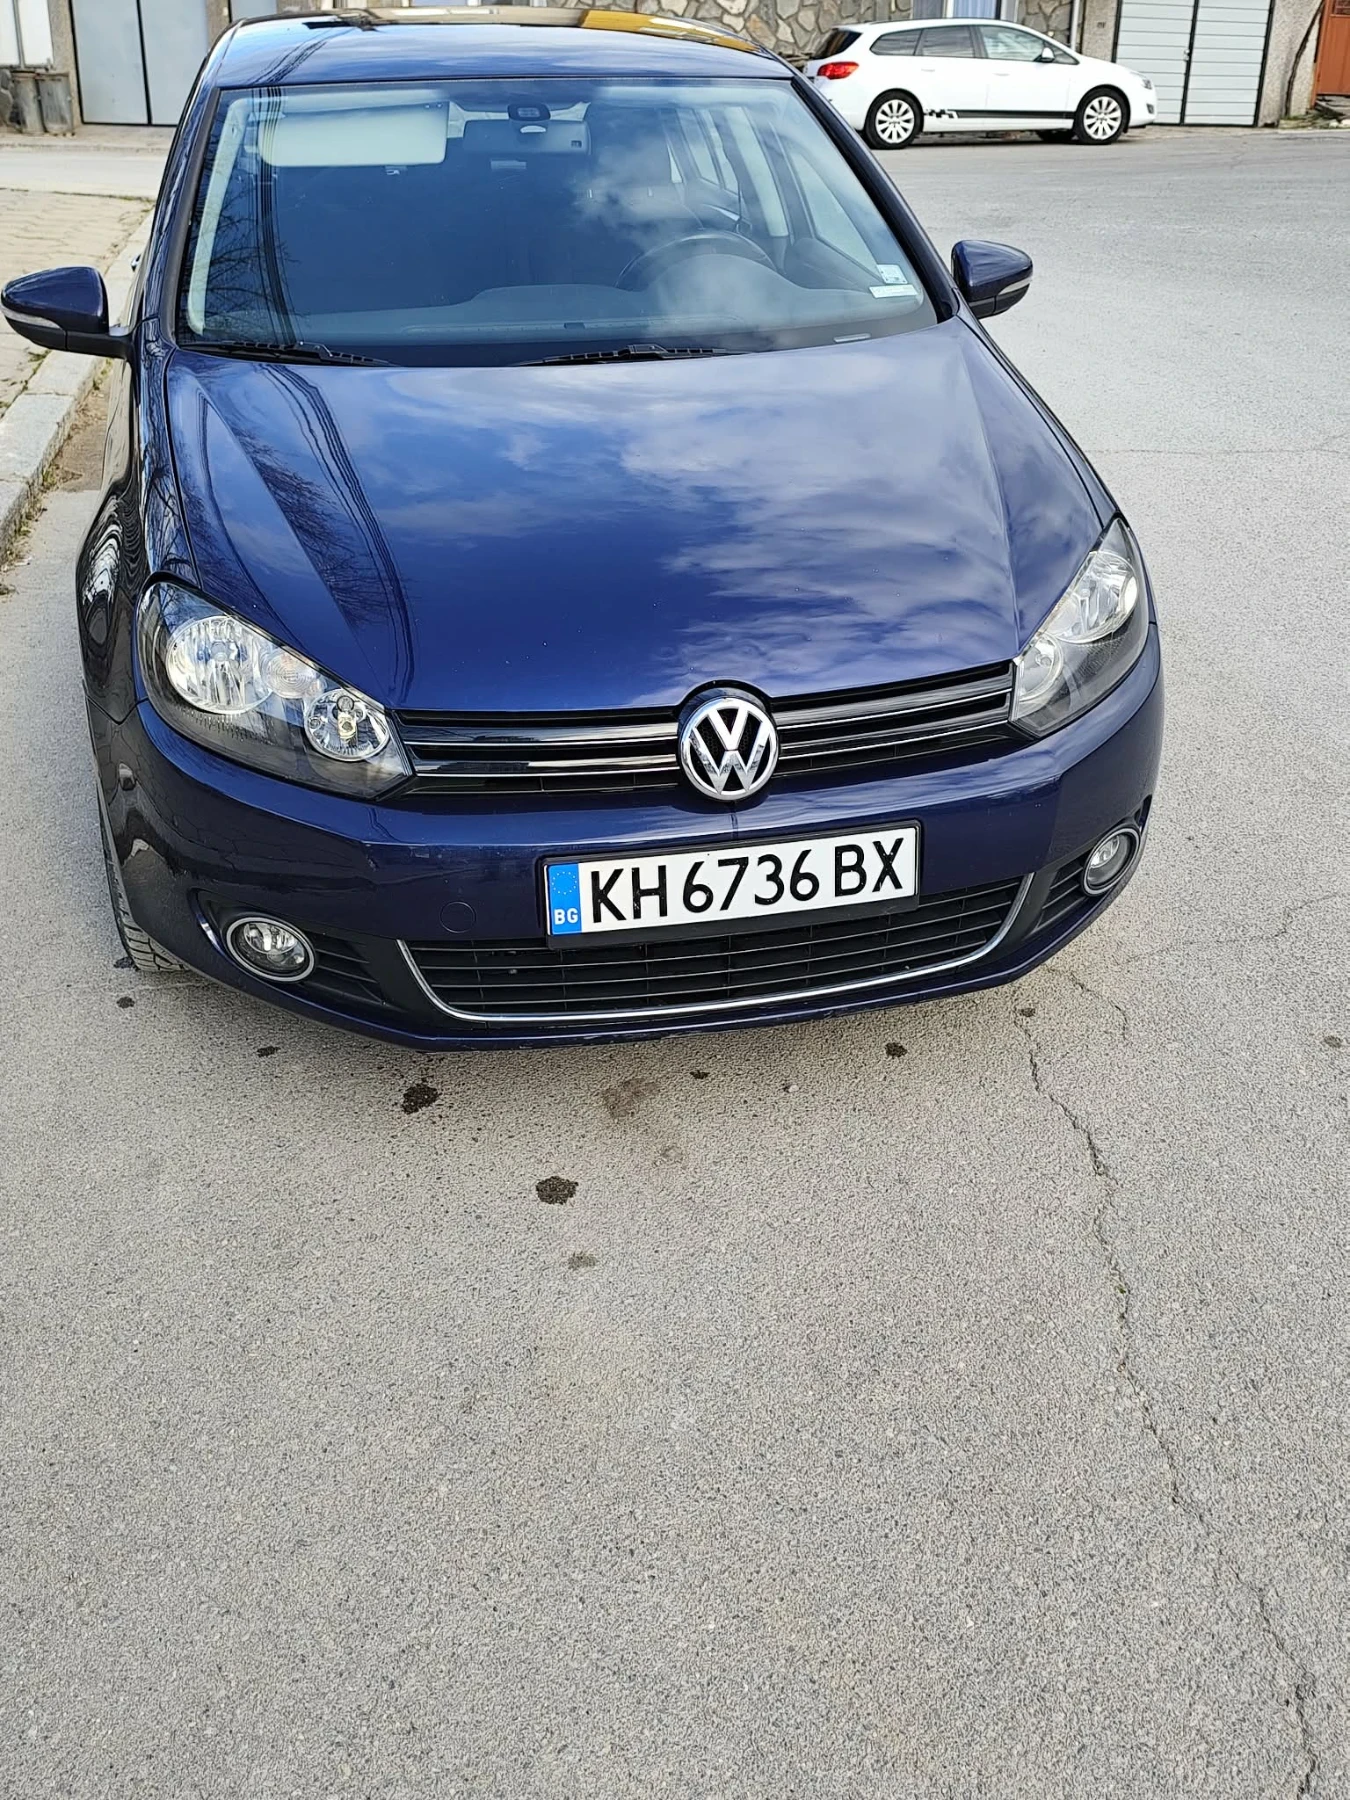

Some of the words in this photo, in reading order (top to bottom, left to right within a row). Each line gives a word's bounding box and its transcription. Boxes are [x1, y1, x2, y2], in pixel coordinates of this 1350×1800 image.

[684, 699, 775, 798] VW
[554, 908, 579, 925] BG
[590, 865, 668, 923] KH
[682, 849, 820, 913] 6736
[834, 837, 904, 897] BX
